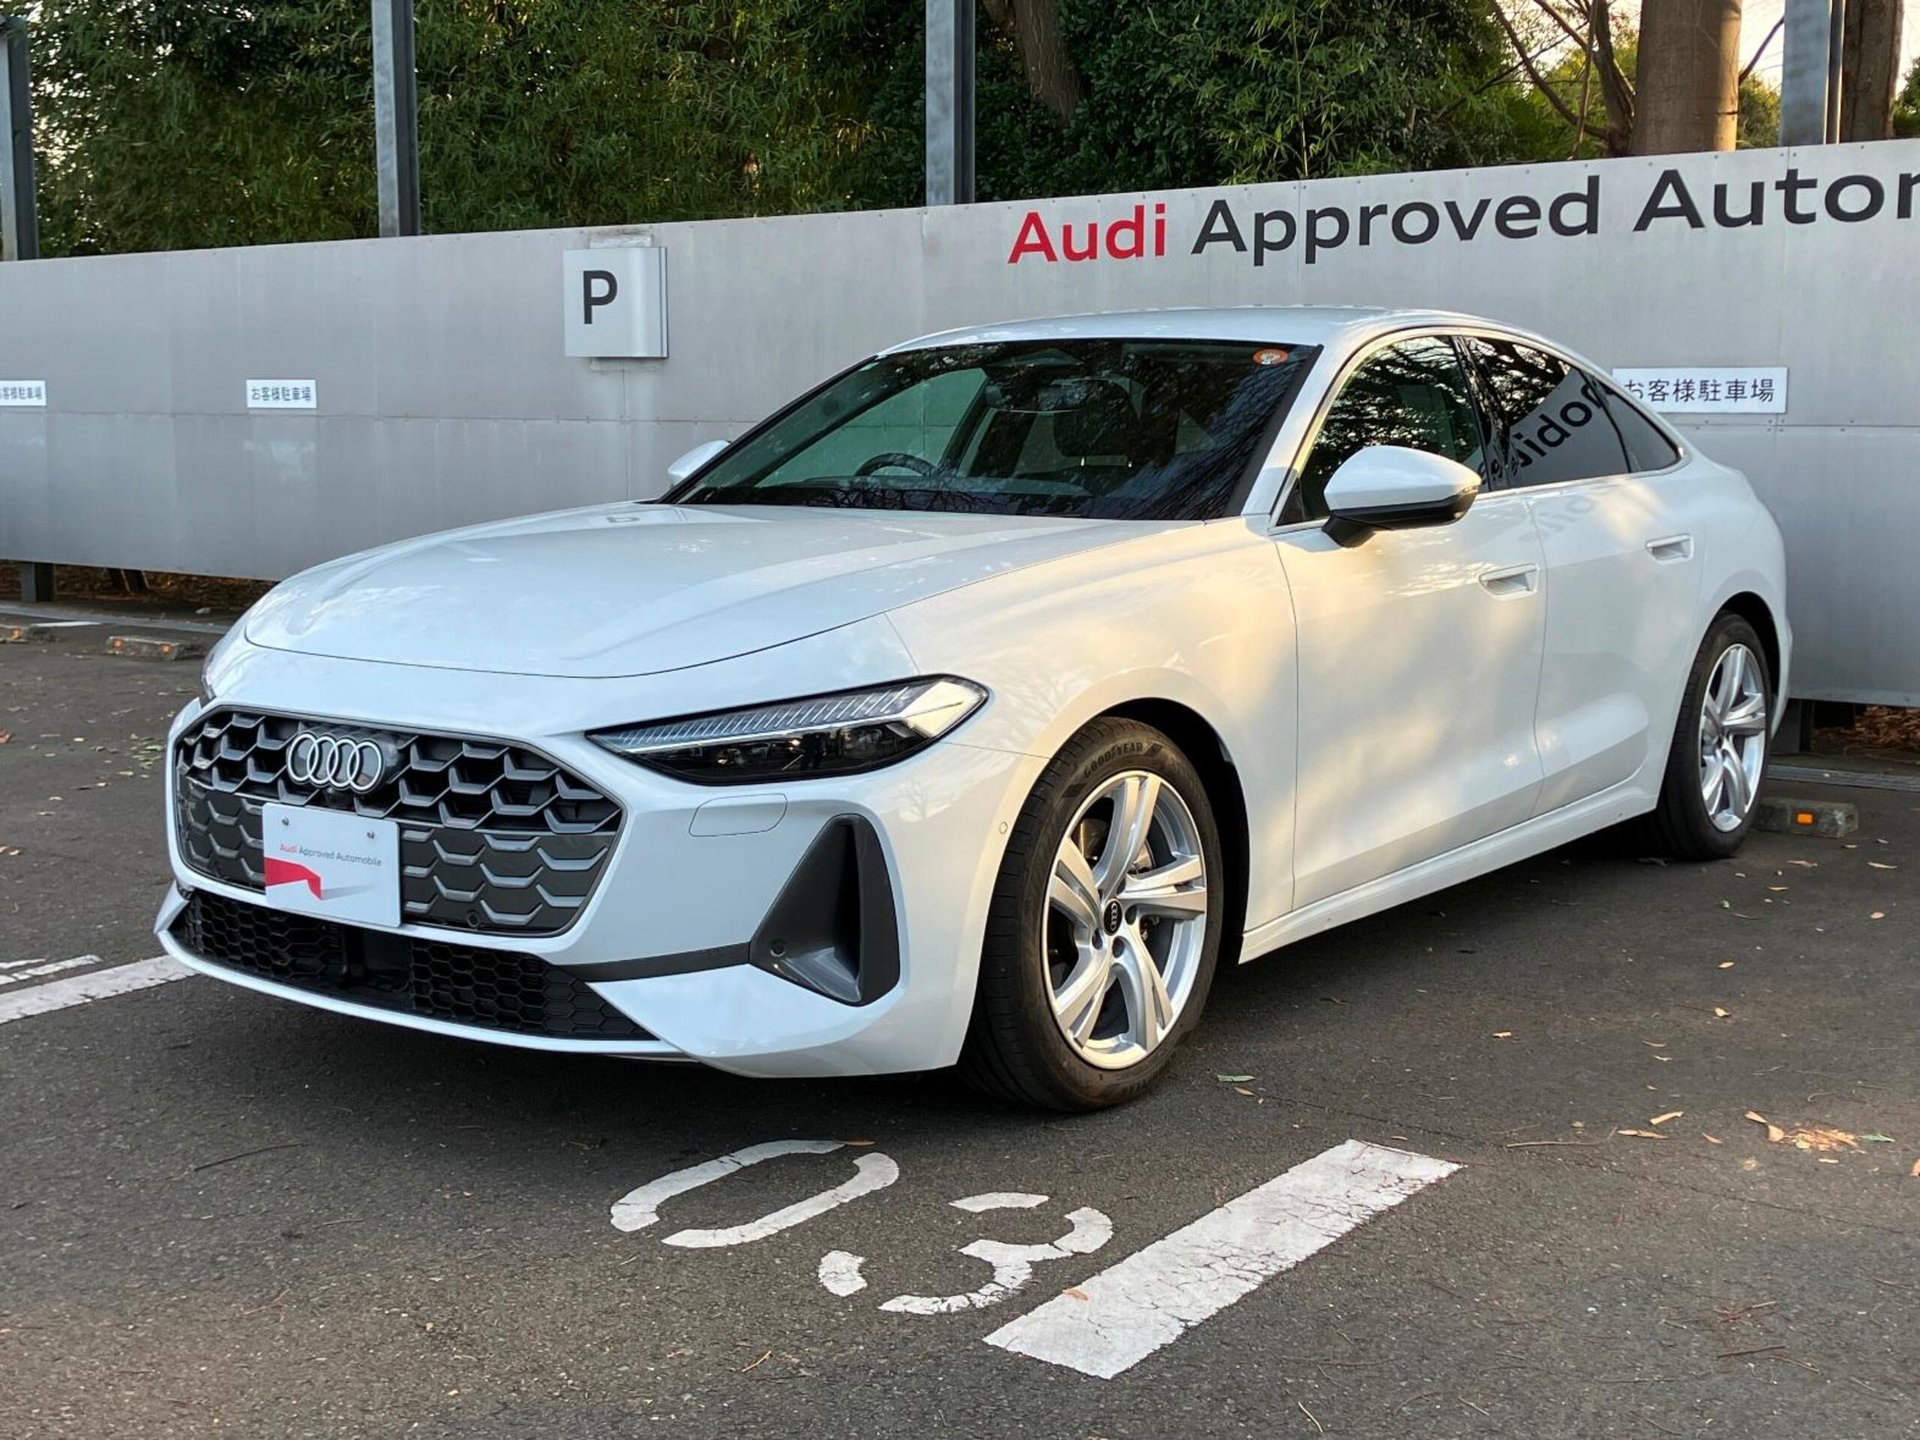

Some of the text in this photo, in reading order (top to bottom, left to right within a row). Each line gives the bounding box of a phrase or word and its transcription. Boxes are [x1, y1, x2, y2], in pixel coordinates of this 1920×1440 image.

[1008, 168, 1920, 267] Audi Approved Auto
[583, 269, 618, 325] P
[250, 386, 312, 401] お客様駐車場
[1624, 378, 1776, 403] お客様駐車場
[1083, 742, 1144, 779] GOODYEAR
[279, 843, 382, 867] Audi Approved Automobile
